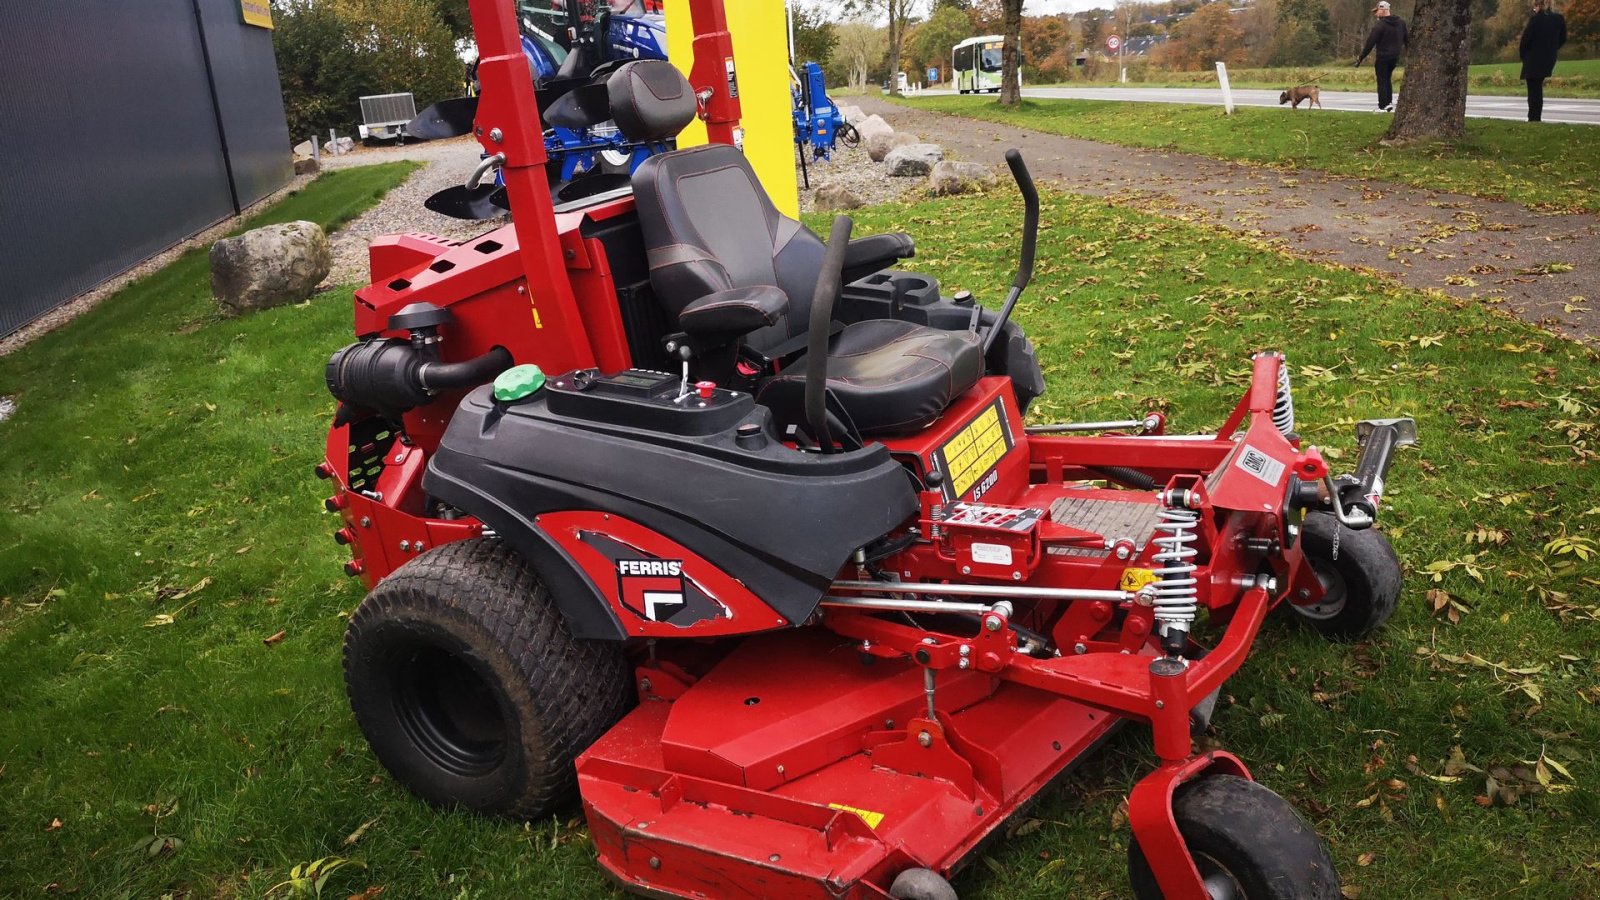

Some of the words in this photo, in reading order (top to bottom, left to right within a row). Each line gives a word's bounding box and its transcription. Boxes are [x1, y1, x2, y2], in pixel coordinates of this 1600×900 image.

[1245, 452, 1264, 471] GMC
[973, 489, 982, 502] IS
[981, 469, 998, 496] 6200
[619, 560, 681, 576] FERRIS
